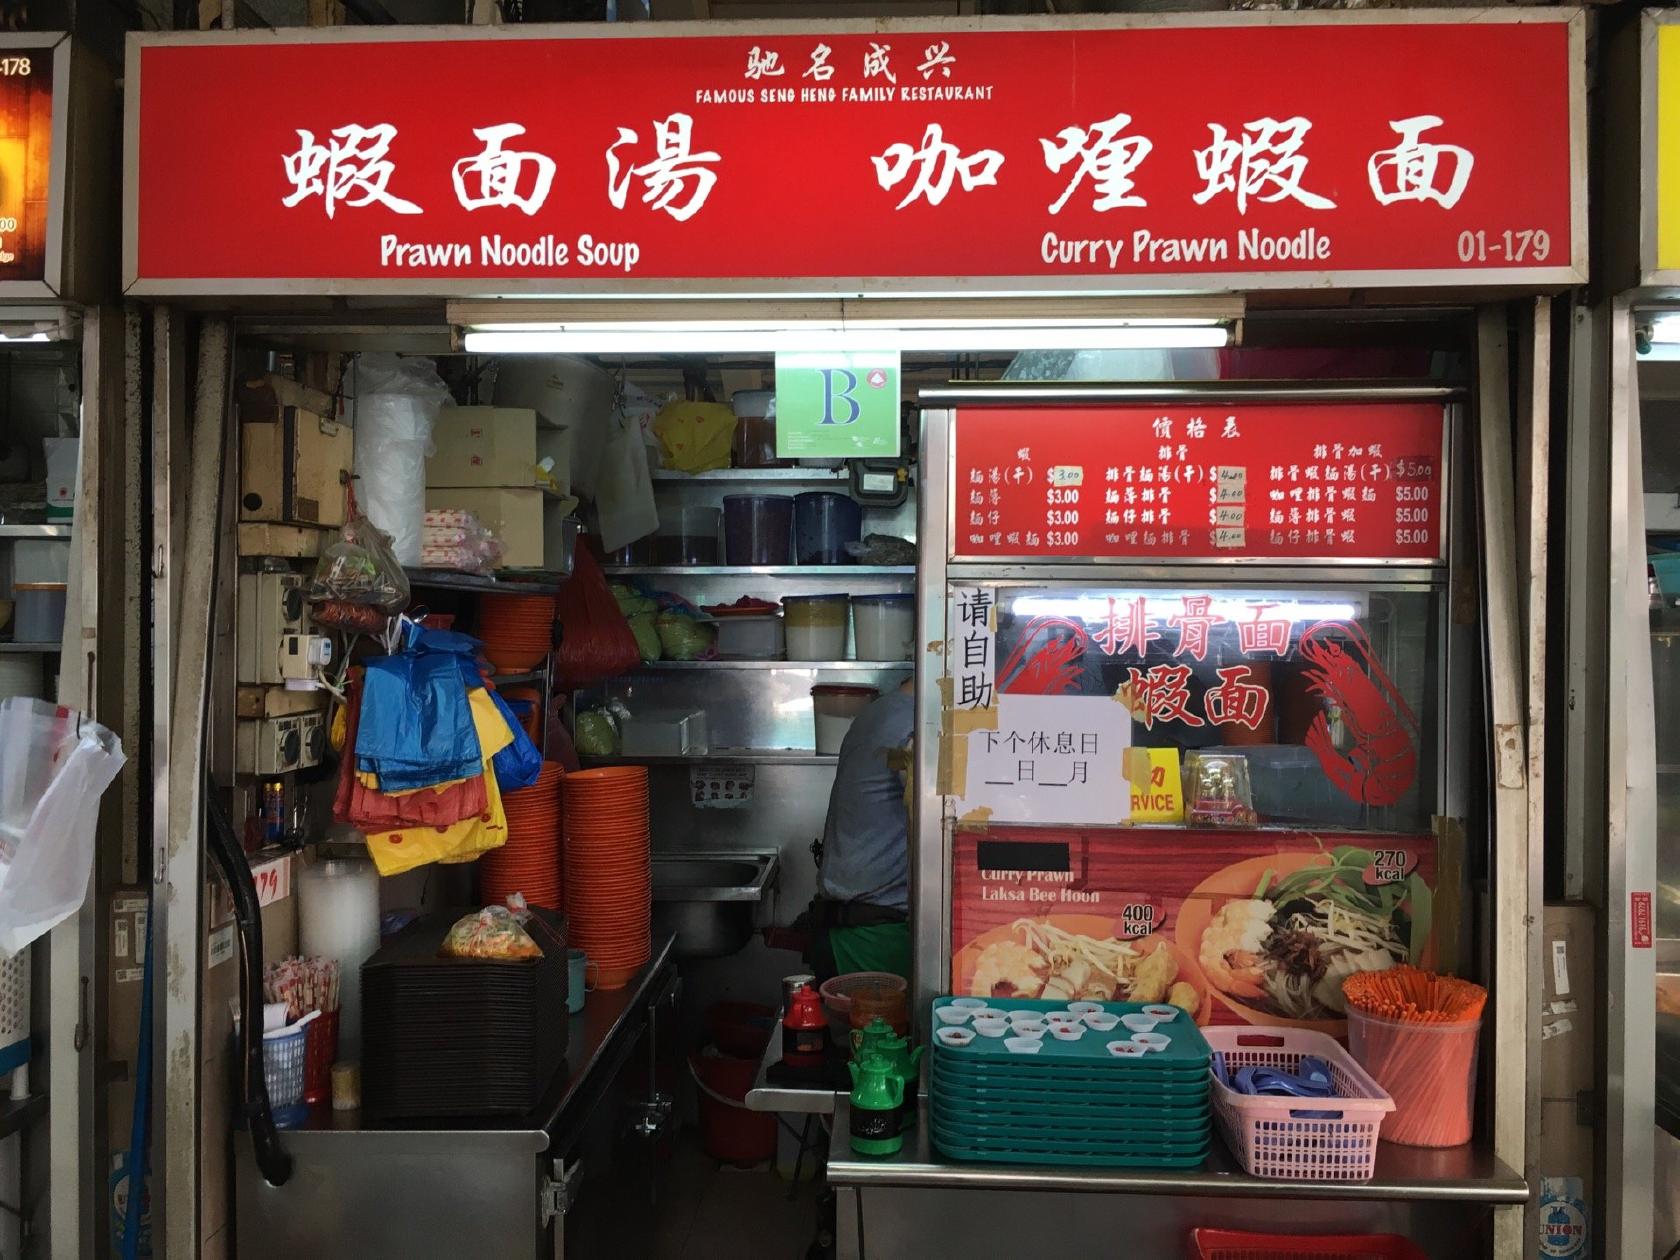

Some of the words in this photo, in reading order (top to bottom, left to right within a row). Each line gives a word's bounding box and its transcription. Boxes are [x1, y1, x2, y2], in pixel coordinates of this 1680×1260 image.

[695, 89, 755, 104] FAMOUS
[760, 88, 796, 103] SENG
[801, 88, 837, 102] HENG
[841, 87, 896, 102] FAMILY
[900, 85, 994, 101] RESTAURANT
[380, 234, 472, 267] Prawn
[480, 234, 570, 267] Noodle
[576, 234, 640, 272] Soup
[1041, 231, 1124, 269] Curry
[1133, 229, 1228, 262] Prawn
[1237, 227, 1331, 261] Noodle
[1457, 229, 1551, 262] 01-179
[817, 368, 861, 425] B
[1157, 444, 1188, 461] 排骨
[1046, 488, 1079, 505] $3.00
[1395, 486, 1429, 502] $5.00
[1046, 509, 1079, 526] $3.00
[1395, 508, 1429, 524] $5.00
[1046, 530, 1079, 547] $3.00
[1395, 529, 1429, 545] $5.00
[1092, 594, 1294, 661] 排骨面
[957, 587, 993, 711] 请自助
[1117, 664, 1270, 731] 蝦面
[979, 731, 1099, 755] 下个休息日
[1130, 794, 1175, 811] RVICE
[1374, 850, 1406, 866] 270
[981, 870, 1023, 884] Curry
[1026, 871, 1075, 882] Prawn
[1375, 867, 1405, 881] kcal
[982, 886, 1025, 901] Laksa
[1029, 887, 1057, 902] Bee
[1060, 888, 1101, 903] Hoon
[1122, 904, 1154, 921] 400
[1123, 921, 1153, 935] kcal
